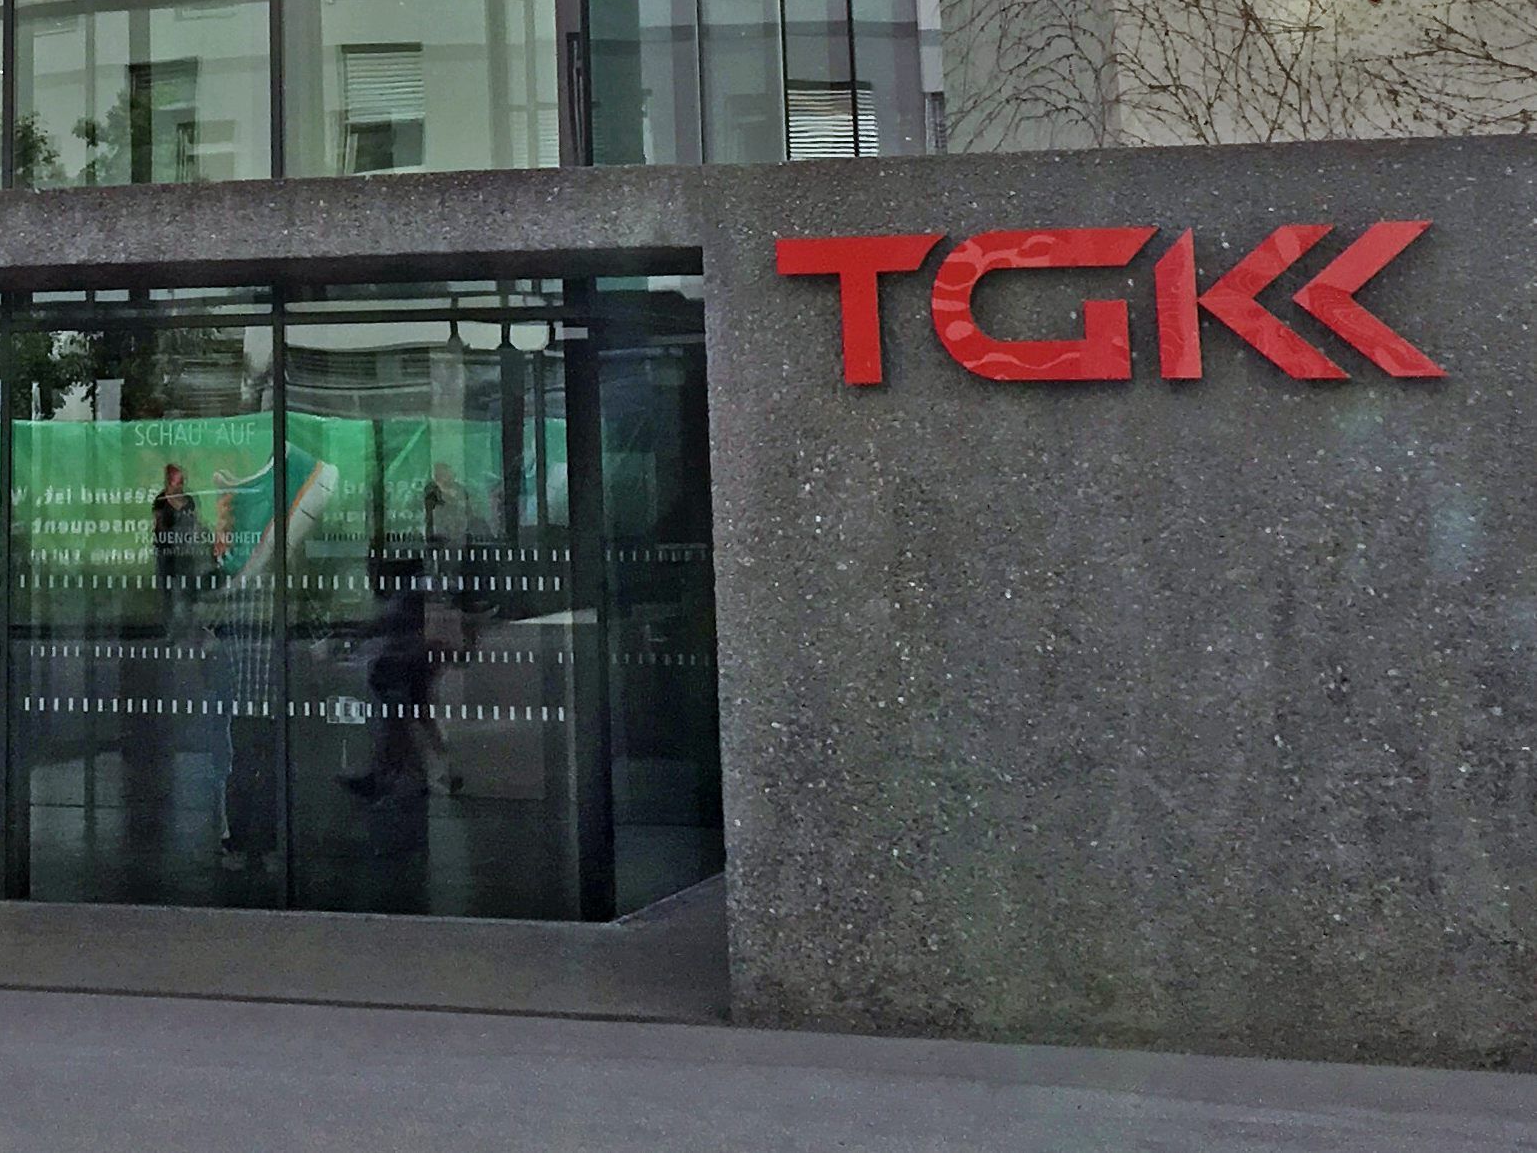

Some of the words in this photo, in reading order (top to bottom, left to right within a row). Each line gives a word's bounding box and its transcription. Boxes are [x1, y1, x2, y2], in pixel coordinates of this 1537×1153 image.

[776, 220, 1447, 385] TGKK
[215, 422, 255, 445] AUF
[135, 531, 261, 545] FRAUENGESUNDHEIT
